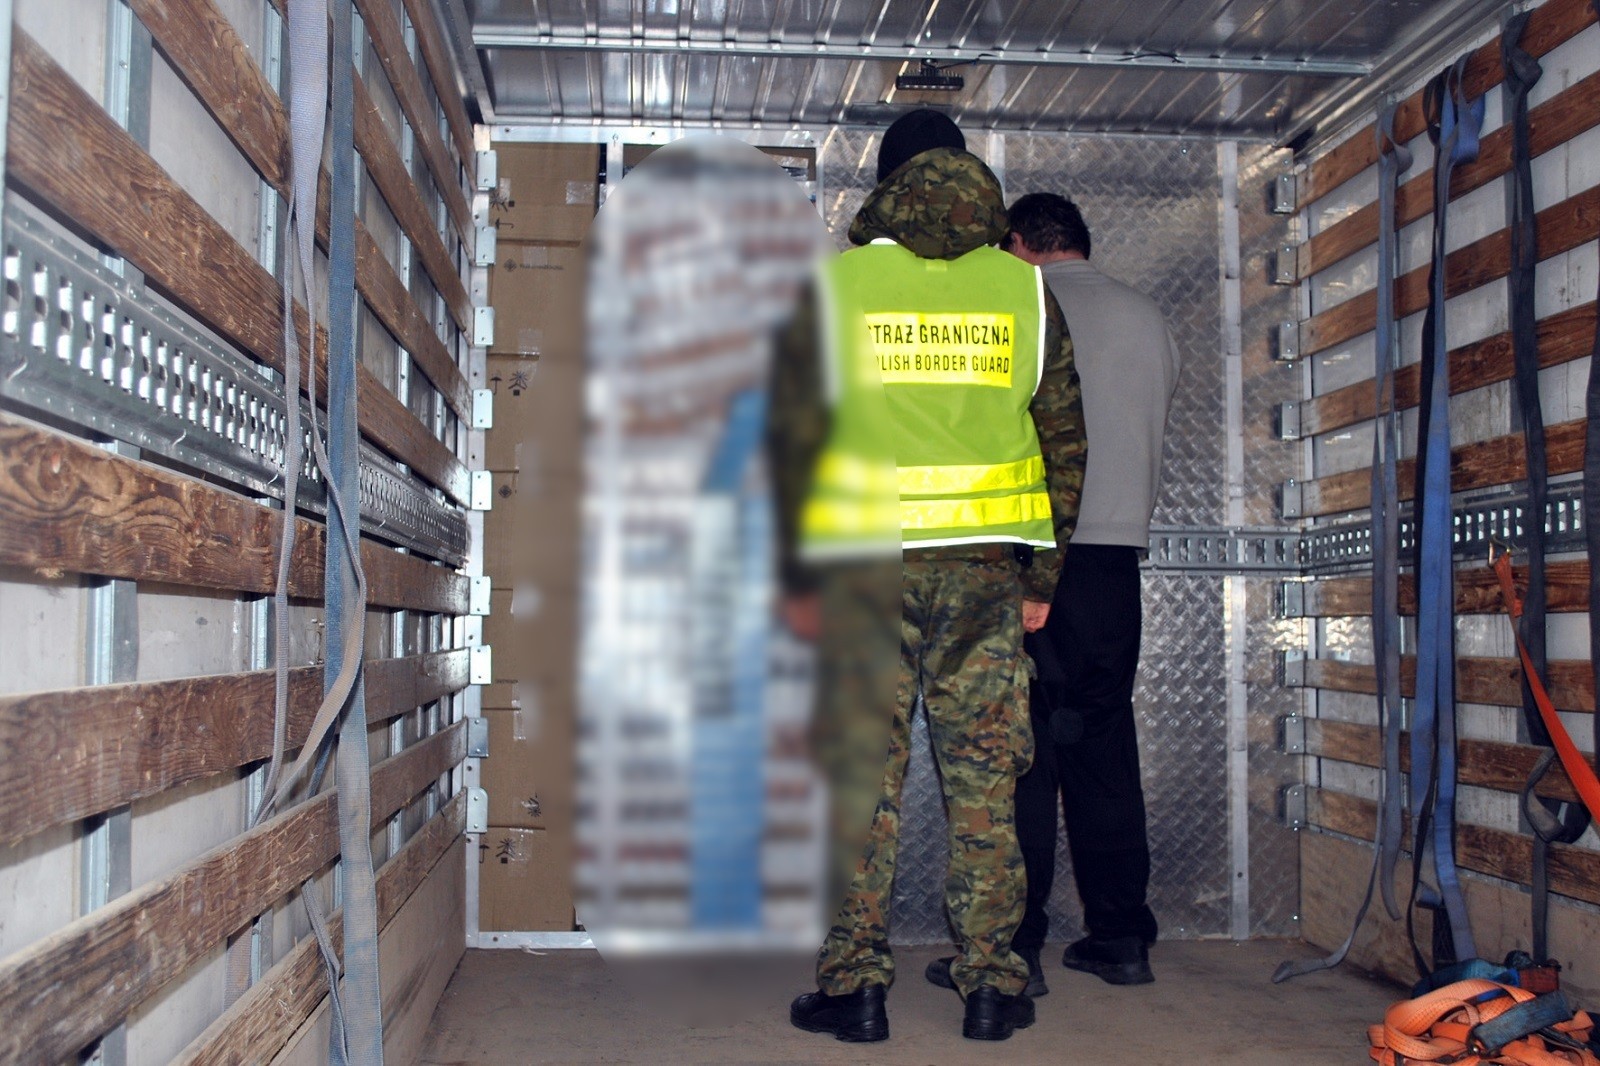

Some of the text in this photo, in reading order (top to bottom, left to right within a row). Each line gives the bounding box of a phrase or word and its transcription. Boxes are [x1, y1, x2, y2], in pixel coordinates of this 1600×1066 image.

[868, 324, 1010, 346] TRAŻ GRANICZNA
[876, 354, 1010, 374] LISH BORDER GUARD
